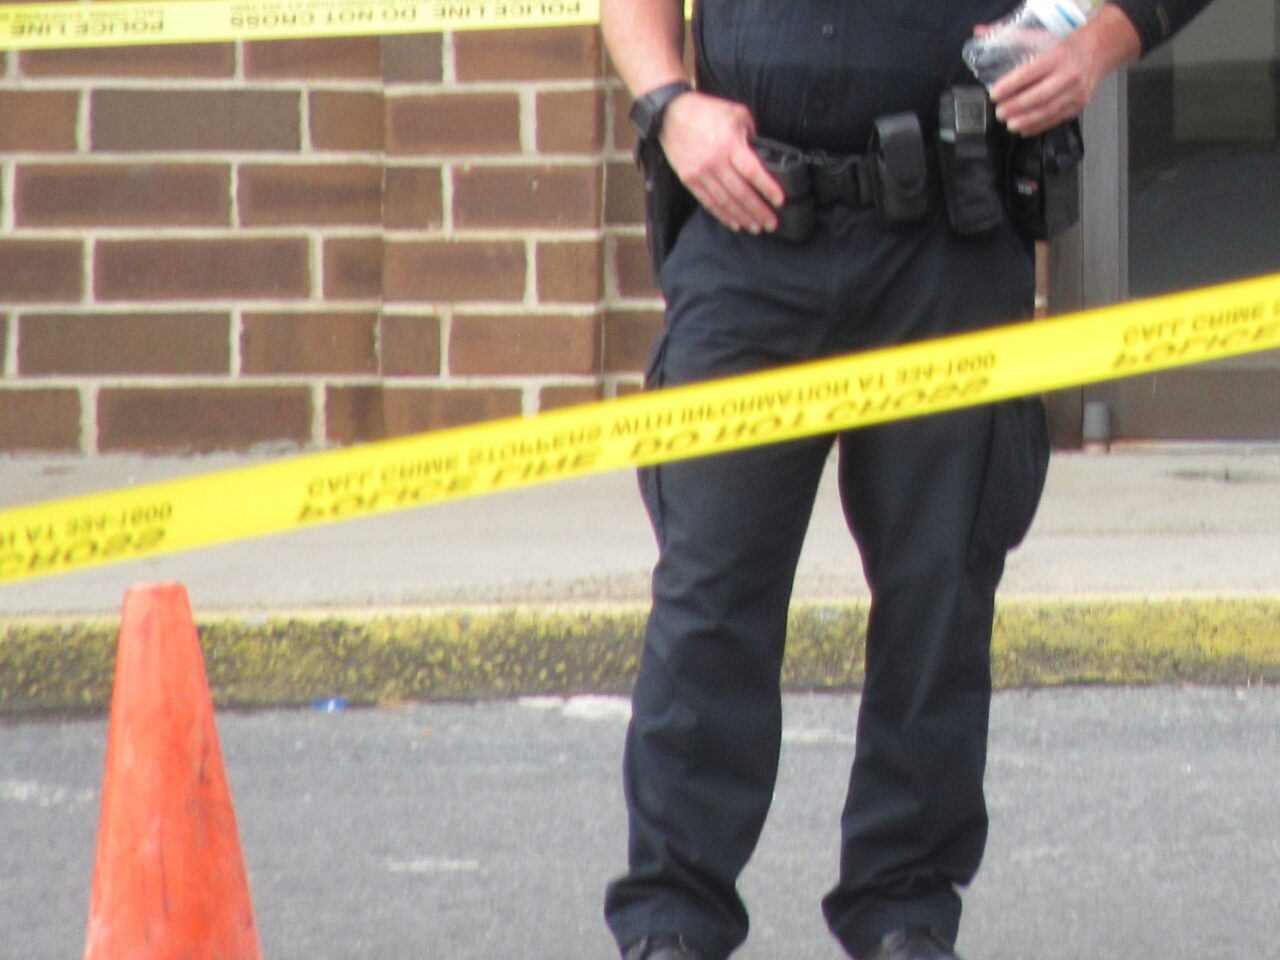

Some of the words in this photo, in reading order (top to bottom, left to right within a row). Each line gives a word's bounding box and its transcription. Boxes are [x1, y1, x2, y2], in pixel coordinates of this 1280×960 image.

[324, 10, 373, 25] NOT
[381, 8, 416, 23] DO
[432, 6, 485, 21] LINE
[494, 2, 580, 18] POLICE
[75, 20, 164, 37] POLICE
[230, 12, 314, 29] CROSS
[10, 23, 66, 39] LINE
